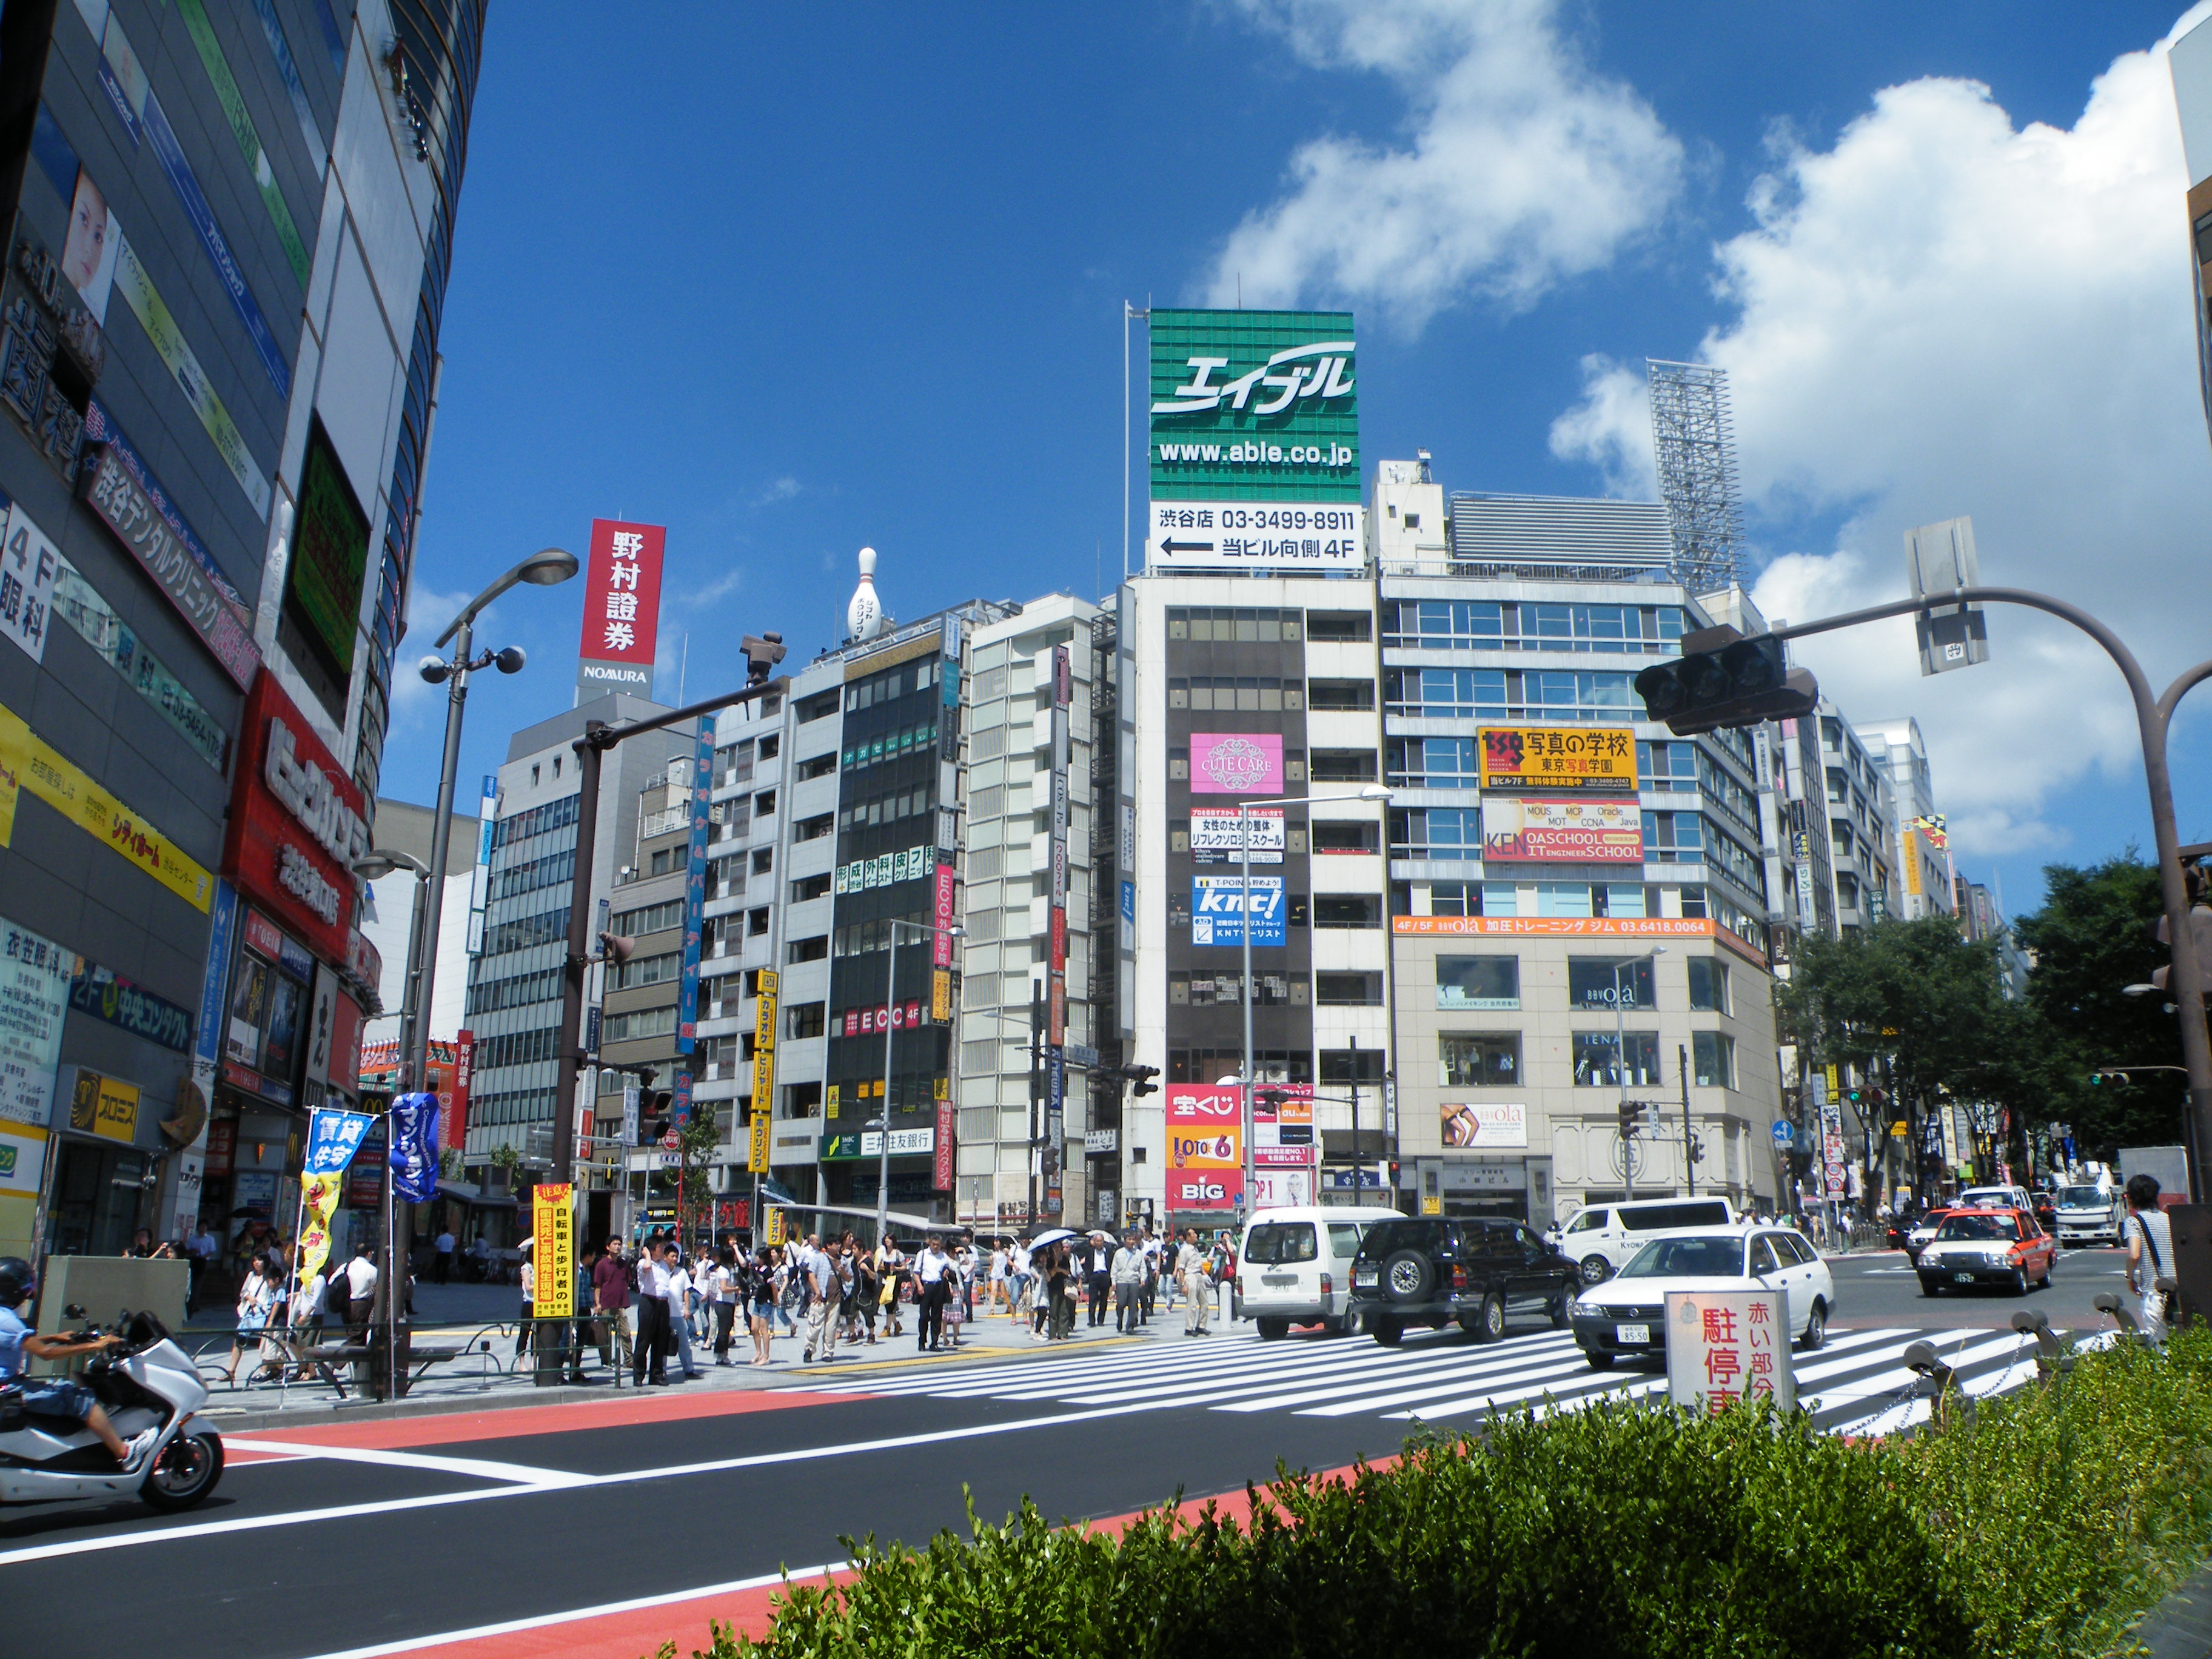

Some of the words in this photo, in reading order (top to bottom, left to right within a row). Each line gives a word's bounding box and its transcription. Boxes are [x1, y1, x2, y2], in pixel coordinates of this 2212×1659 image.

[1151, 342, 1356, 414] エイブル
[1159, 441, 1352, 467] www.able.co.jp
[1159, 509, 1213, 528] 渋谷店
[1222, 511, 1354, 530] 03-3499-8911
[9, 526, 55, 588] 4F
[95, 456, 218, 631] 渋谷デンタルクリニック
[1222, 539, 1319, 558] 当ビル向側
[1324, 540, 1354, 558] 4F
[604, 531, 644, 651] 野村證券
[0, 570, 45, 647] 眼科
[584, 666, 647, 684] NOMURA
[846, 744, 882, 762] ナガセ
[1527, 732, 1628, 757] 写真の学校
[1201, 756, 1235, 772] CUTE
[1238, 756, 1273, 773] CARE
[1542, 758, 1613, 773] 東京写真学園
[1490, 776, 1523, 785] 当ビル7F
[1526, 776, 1583, 786] 無料体験実施中
[1527, 806, 1552, 816] MOUS
[1566, 807, 1583, 816] MCP
[1597, 806, 1623, 816] Oracle
[1548, 817, 1567, 826] MOT
[1581, 818, 1604, 826] CCNA
[1620, 817, 1638, 826] Java
[112, 813, 160, 868] シティホーム
[1487, 833, 1527, 856] KEN
[938, 874, 950, 917] ECC
[1199, 889, 1283, 920] knt!
[1452, 918, 1480, 933] olá
[1486, 919, 1584, 933] 加圧トレーニング
[1590, 920, 1615, 932] ジム
[1620, 922, 1705, 933] 03.6418.0064
[118, 987, 189, 1047] 中央コンタクト
[762, 1000, 770, 1044] カラオケ
[862, 1007, 902, 1030] ECC
[907, 1008, 919, 1021] 4F
[457, 1043, 471, 1087] 野村證券
[757, 1056, 766, 1105] ビリヤード
[98, 1094, 135, 1125] プロミス
[1173, 1095, 1233, 1115] 宝くじ
[318, 1116, 364, 1145] 賃貸
[755, 1118, 763, 1167] ボウリング
[866, 1133, 928, 1150] 三井住友銀行
[1215, 1134, 1231, 1158] 6
[541, 1185, 568, 1199] 注意!
[1181, 1184, 1225, 1200] BIG
[770, 1208, 780, 1242] カラオケ
[539, 1209, 552, 1301] 衝突死亡事故発生現場
[556, 1207, 568, 1301] 自転車と歩行者の
[1749, 1302, 1774, 1399] 赤い部分
